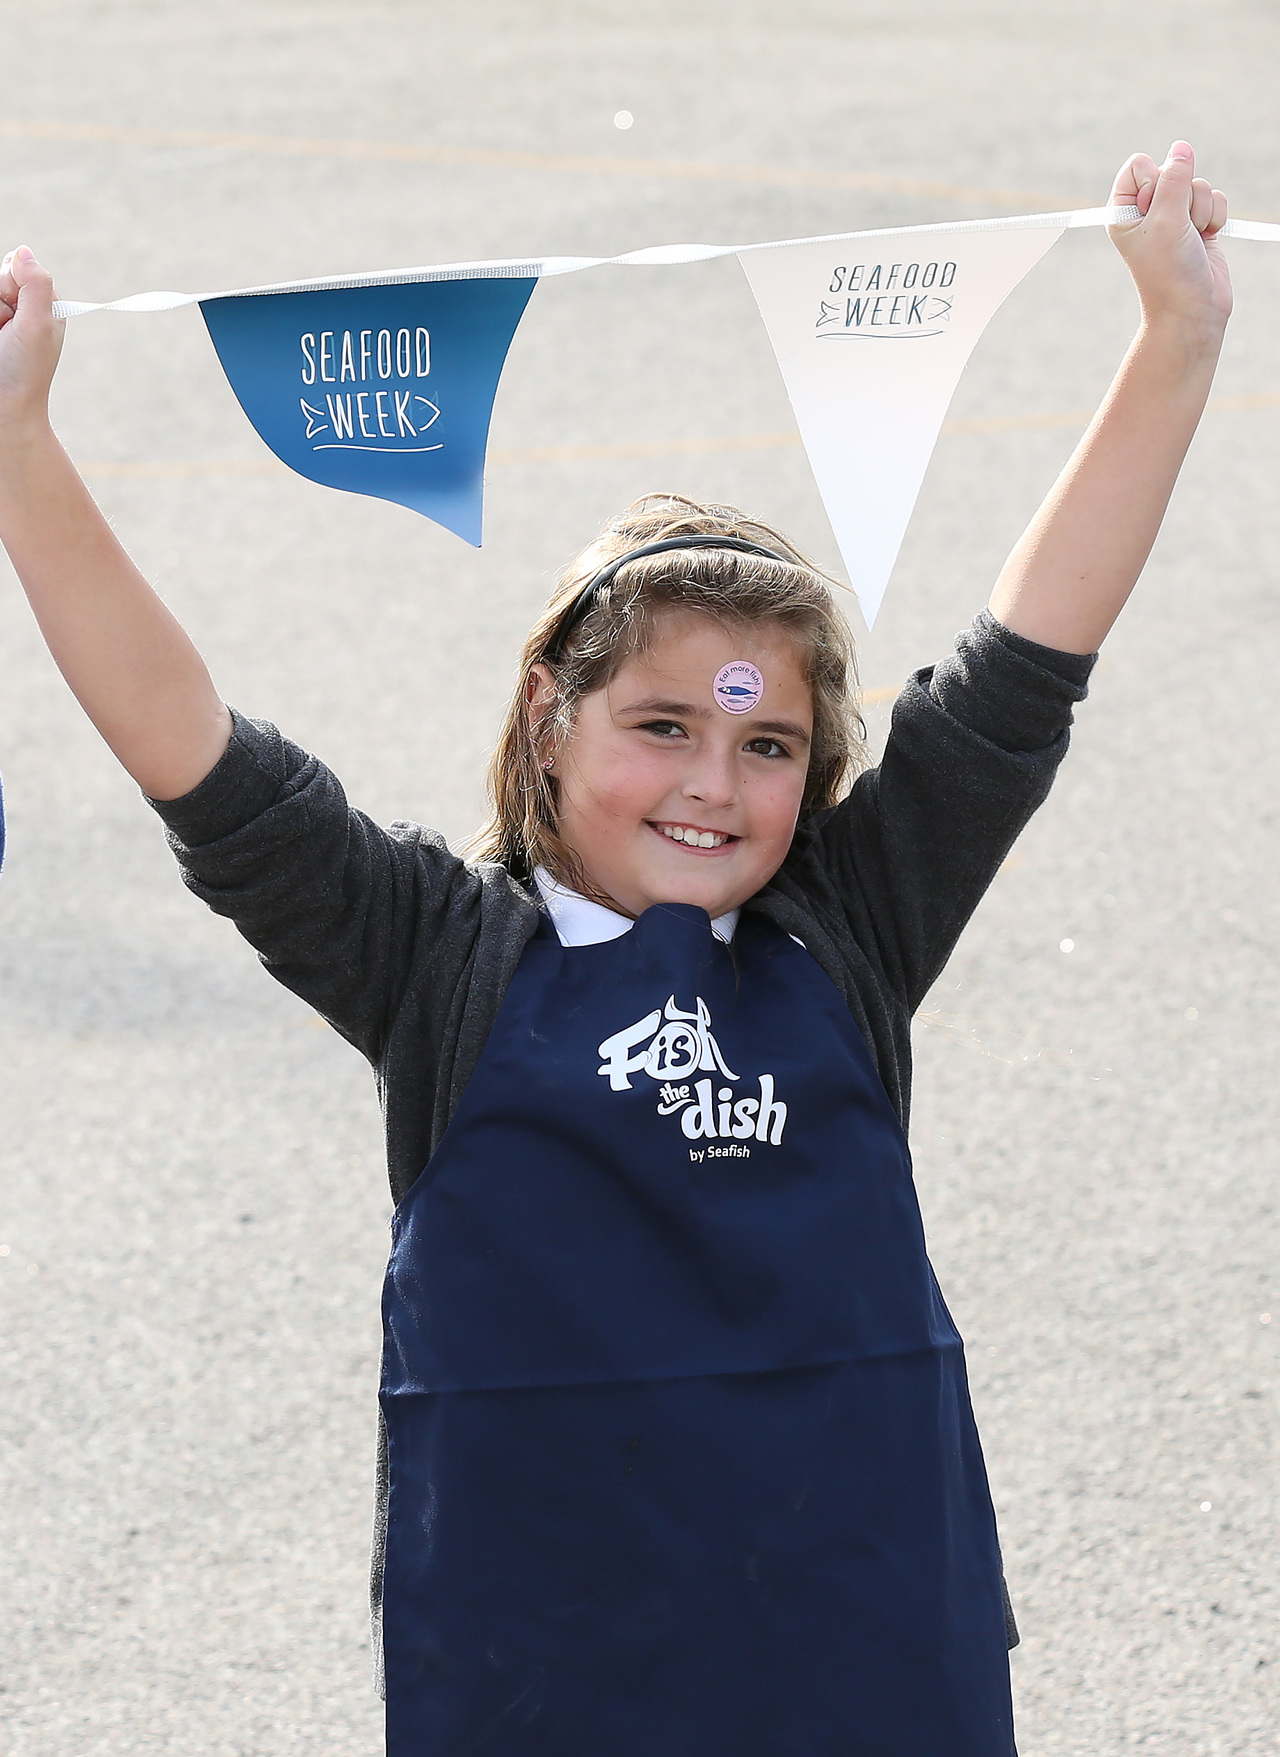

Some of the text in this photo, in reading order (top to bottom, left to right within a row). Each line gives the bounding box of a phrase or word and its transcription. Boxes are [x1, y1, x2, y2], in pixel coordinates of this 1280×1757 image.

[829, 261, 957, 293] SEAFOOD
[845, 294, 929, 327] WEEK
[300, 326, 431, 385] SEAFOOD
[325, 390, 418, 440] WEEK
[718, 669, 730, 683] Eat
[730, 665, 750, 674] more
[658, 1081, 690, 1105] the
[680, 1073, 788, 1146] dish
[689, 1144, 751, 1164] by Seafish
